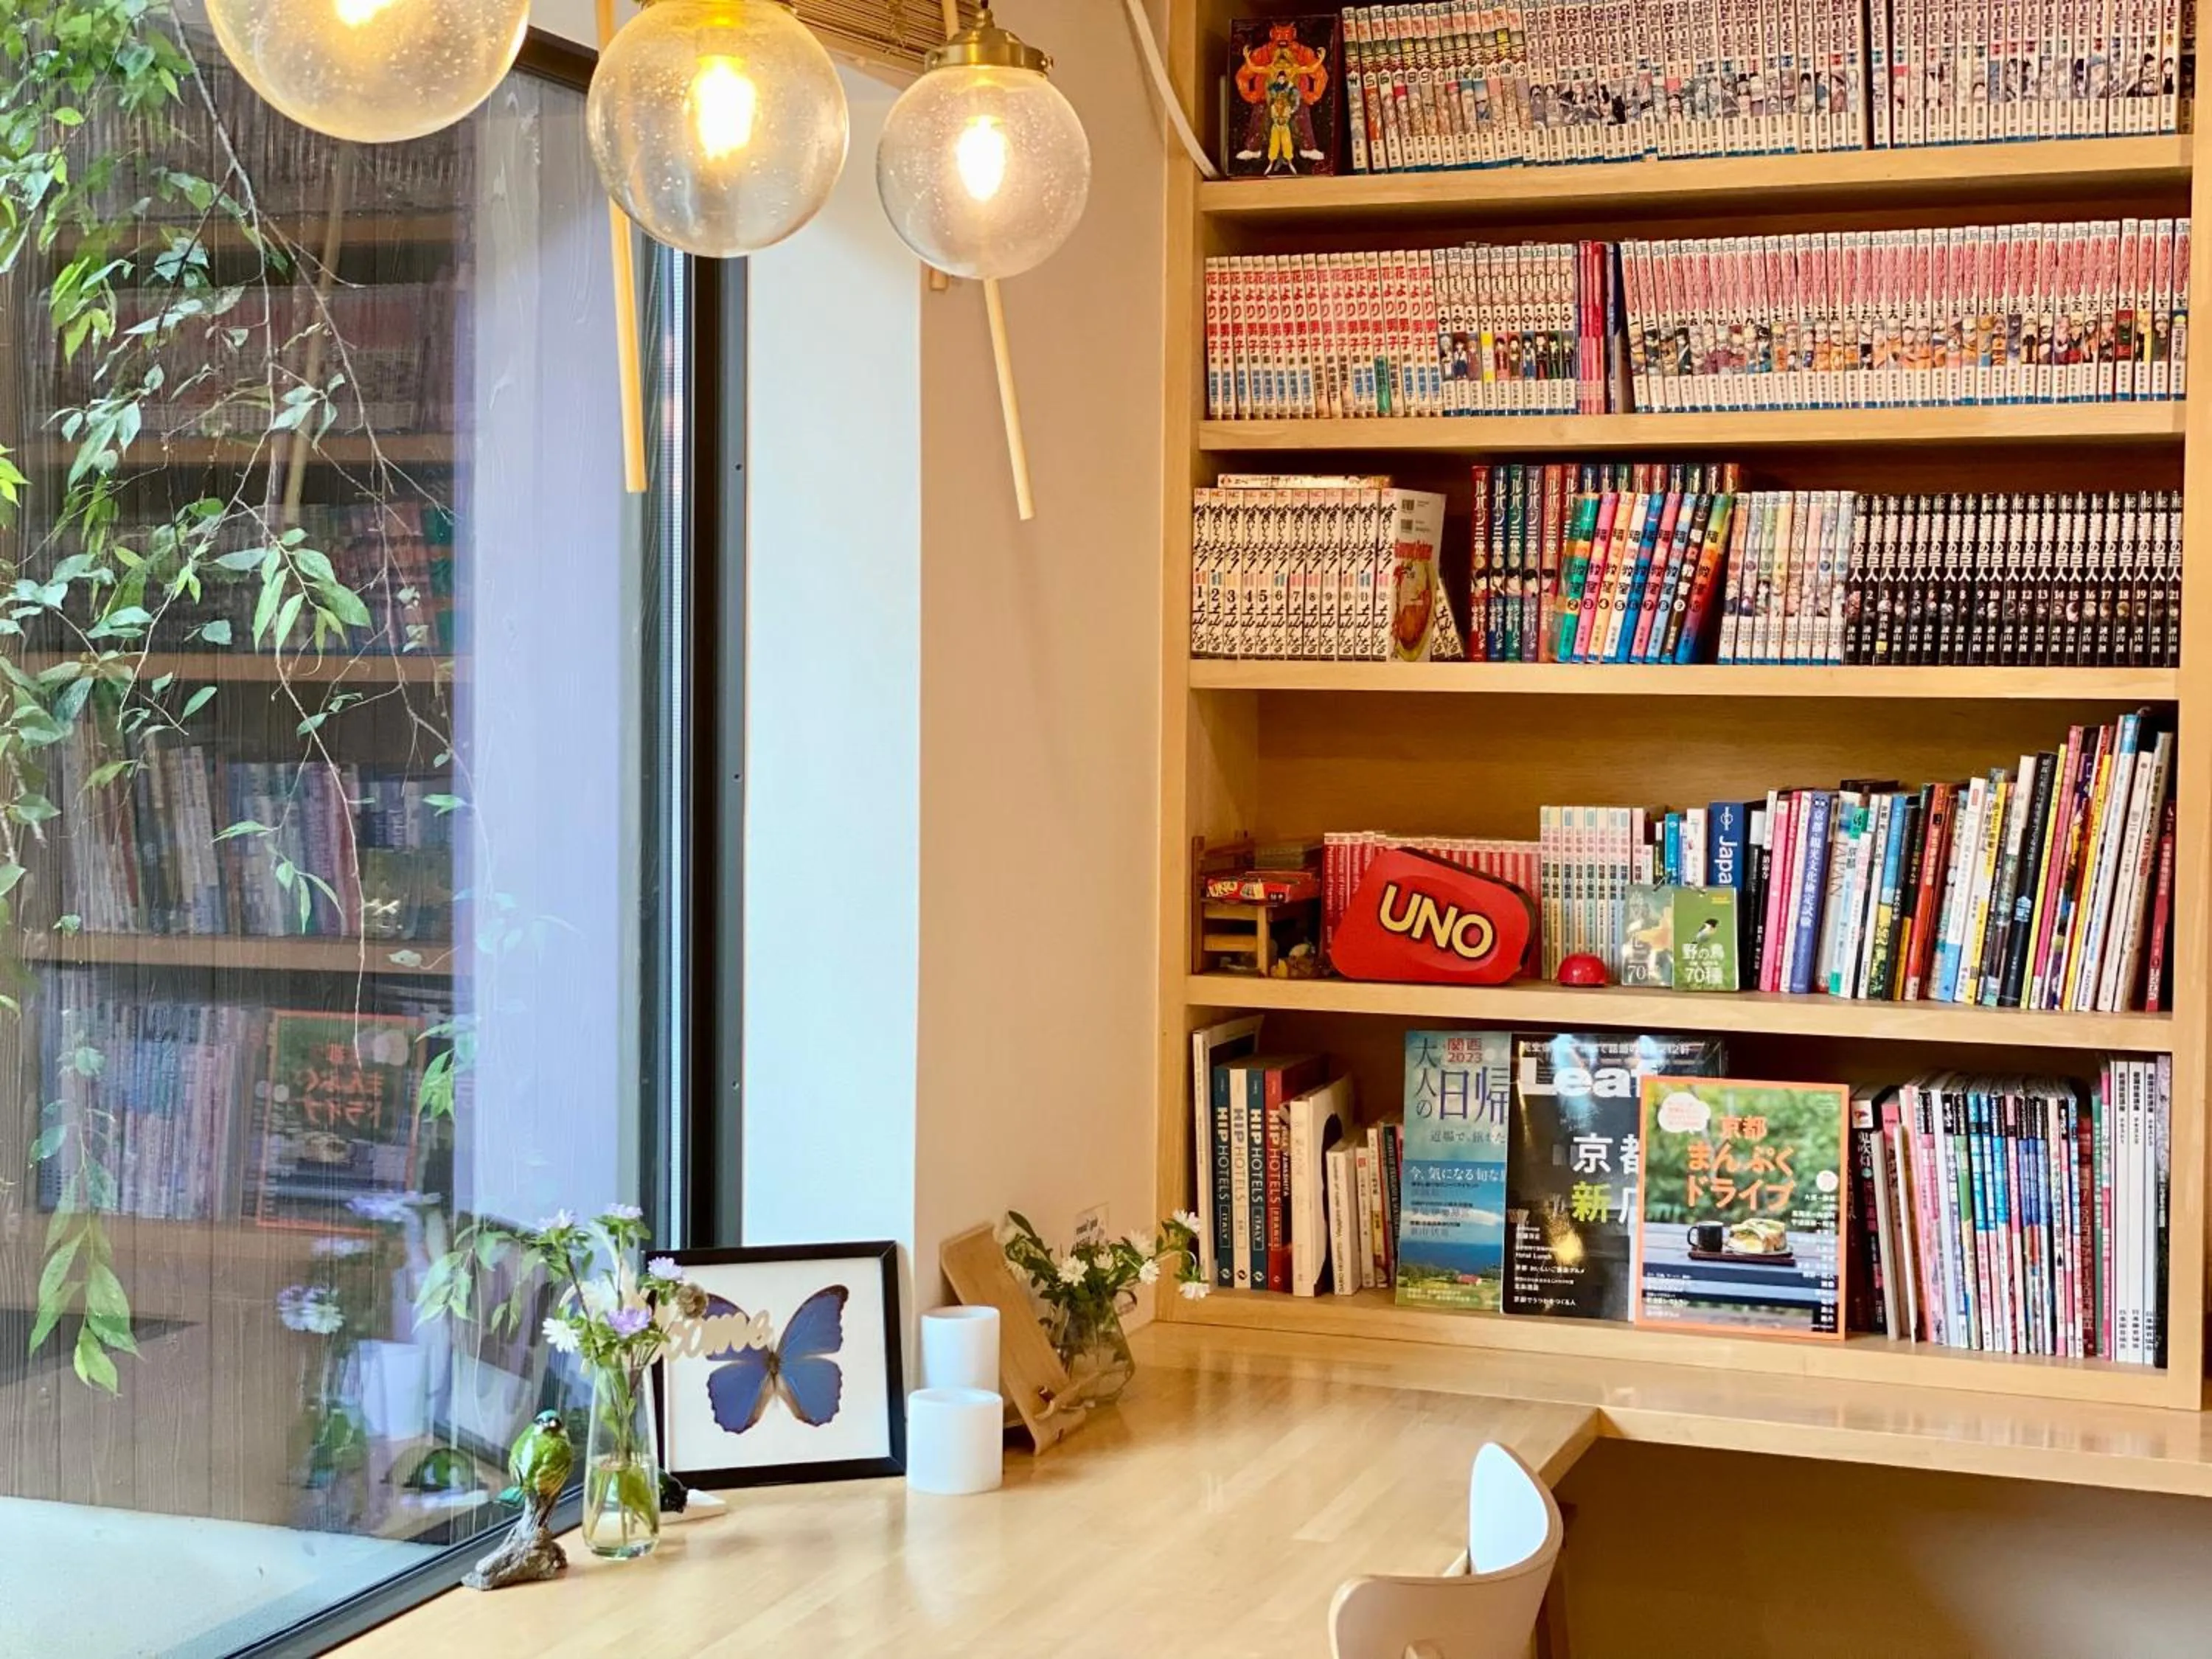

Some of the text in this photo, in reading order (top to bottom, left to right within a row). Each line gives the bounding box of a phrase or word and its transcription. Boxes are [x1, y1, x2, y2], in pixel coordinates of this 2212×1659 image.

[1197, 585, 1203, 599] 1
[1211, 588, 1220, 602] 2
[1226, 589, 1236, 602] 3
[1244, 589, 1253, 603] 4
[1259, 589, 1268, 603] 5
[1274, 589, 1283, 602] 6
[1292, 591, 1300, 602] 7
[1714, 835, 1738, 886] Japa
[1208, 880, 1238, 897] UNO
[1379, 884, 1494, 959] UNO
[1447, 1051, 1484, 1063] 2023
[1414, 1037, 1439, 1119] 大人の
[1521, 1057, 1658, 1099] Leaf
[1719, 1116, 1768, 1140] 京都
[1217, 1107, 1229, 1201] HIP HOTELS
[1234, 1108, 1246, 1202] HIP HOTELS
[1250, 1108, 1264, 1203] HIP HOTELS
[1268, 1109, 1281, 1204] HIP HOTELS
[1687, 1141, 1795, 1178] まんぷく
[1687, 1178, 1795, 1212] ドライブ
